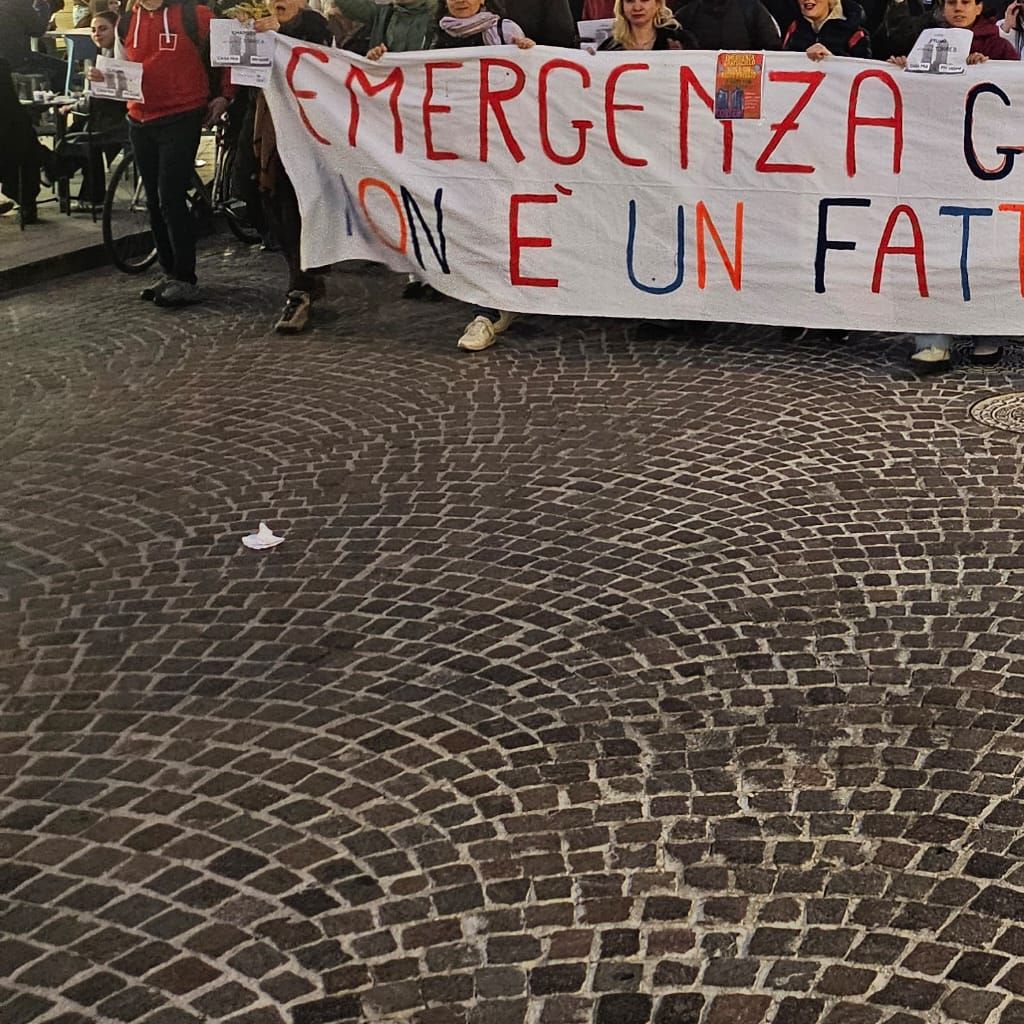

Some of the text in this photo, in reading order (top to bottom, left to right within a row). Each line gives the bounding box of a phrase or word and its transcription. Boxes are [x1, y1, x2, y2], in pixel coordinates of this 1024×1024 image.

[286, 46, 904, 178] EMERGENZA
[509, 183, 572, 288] È
[626, 199, 744, 295] UN
